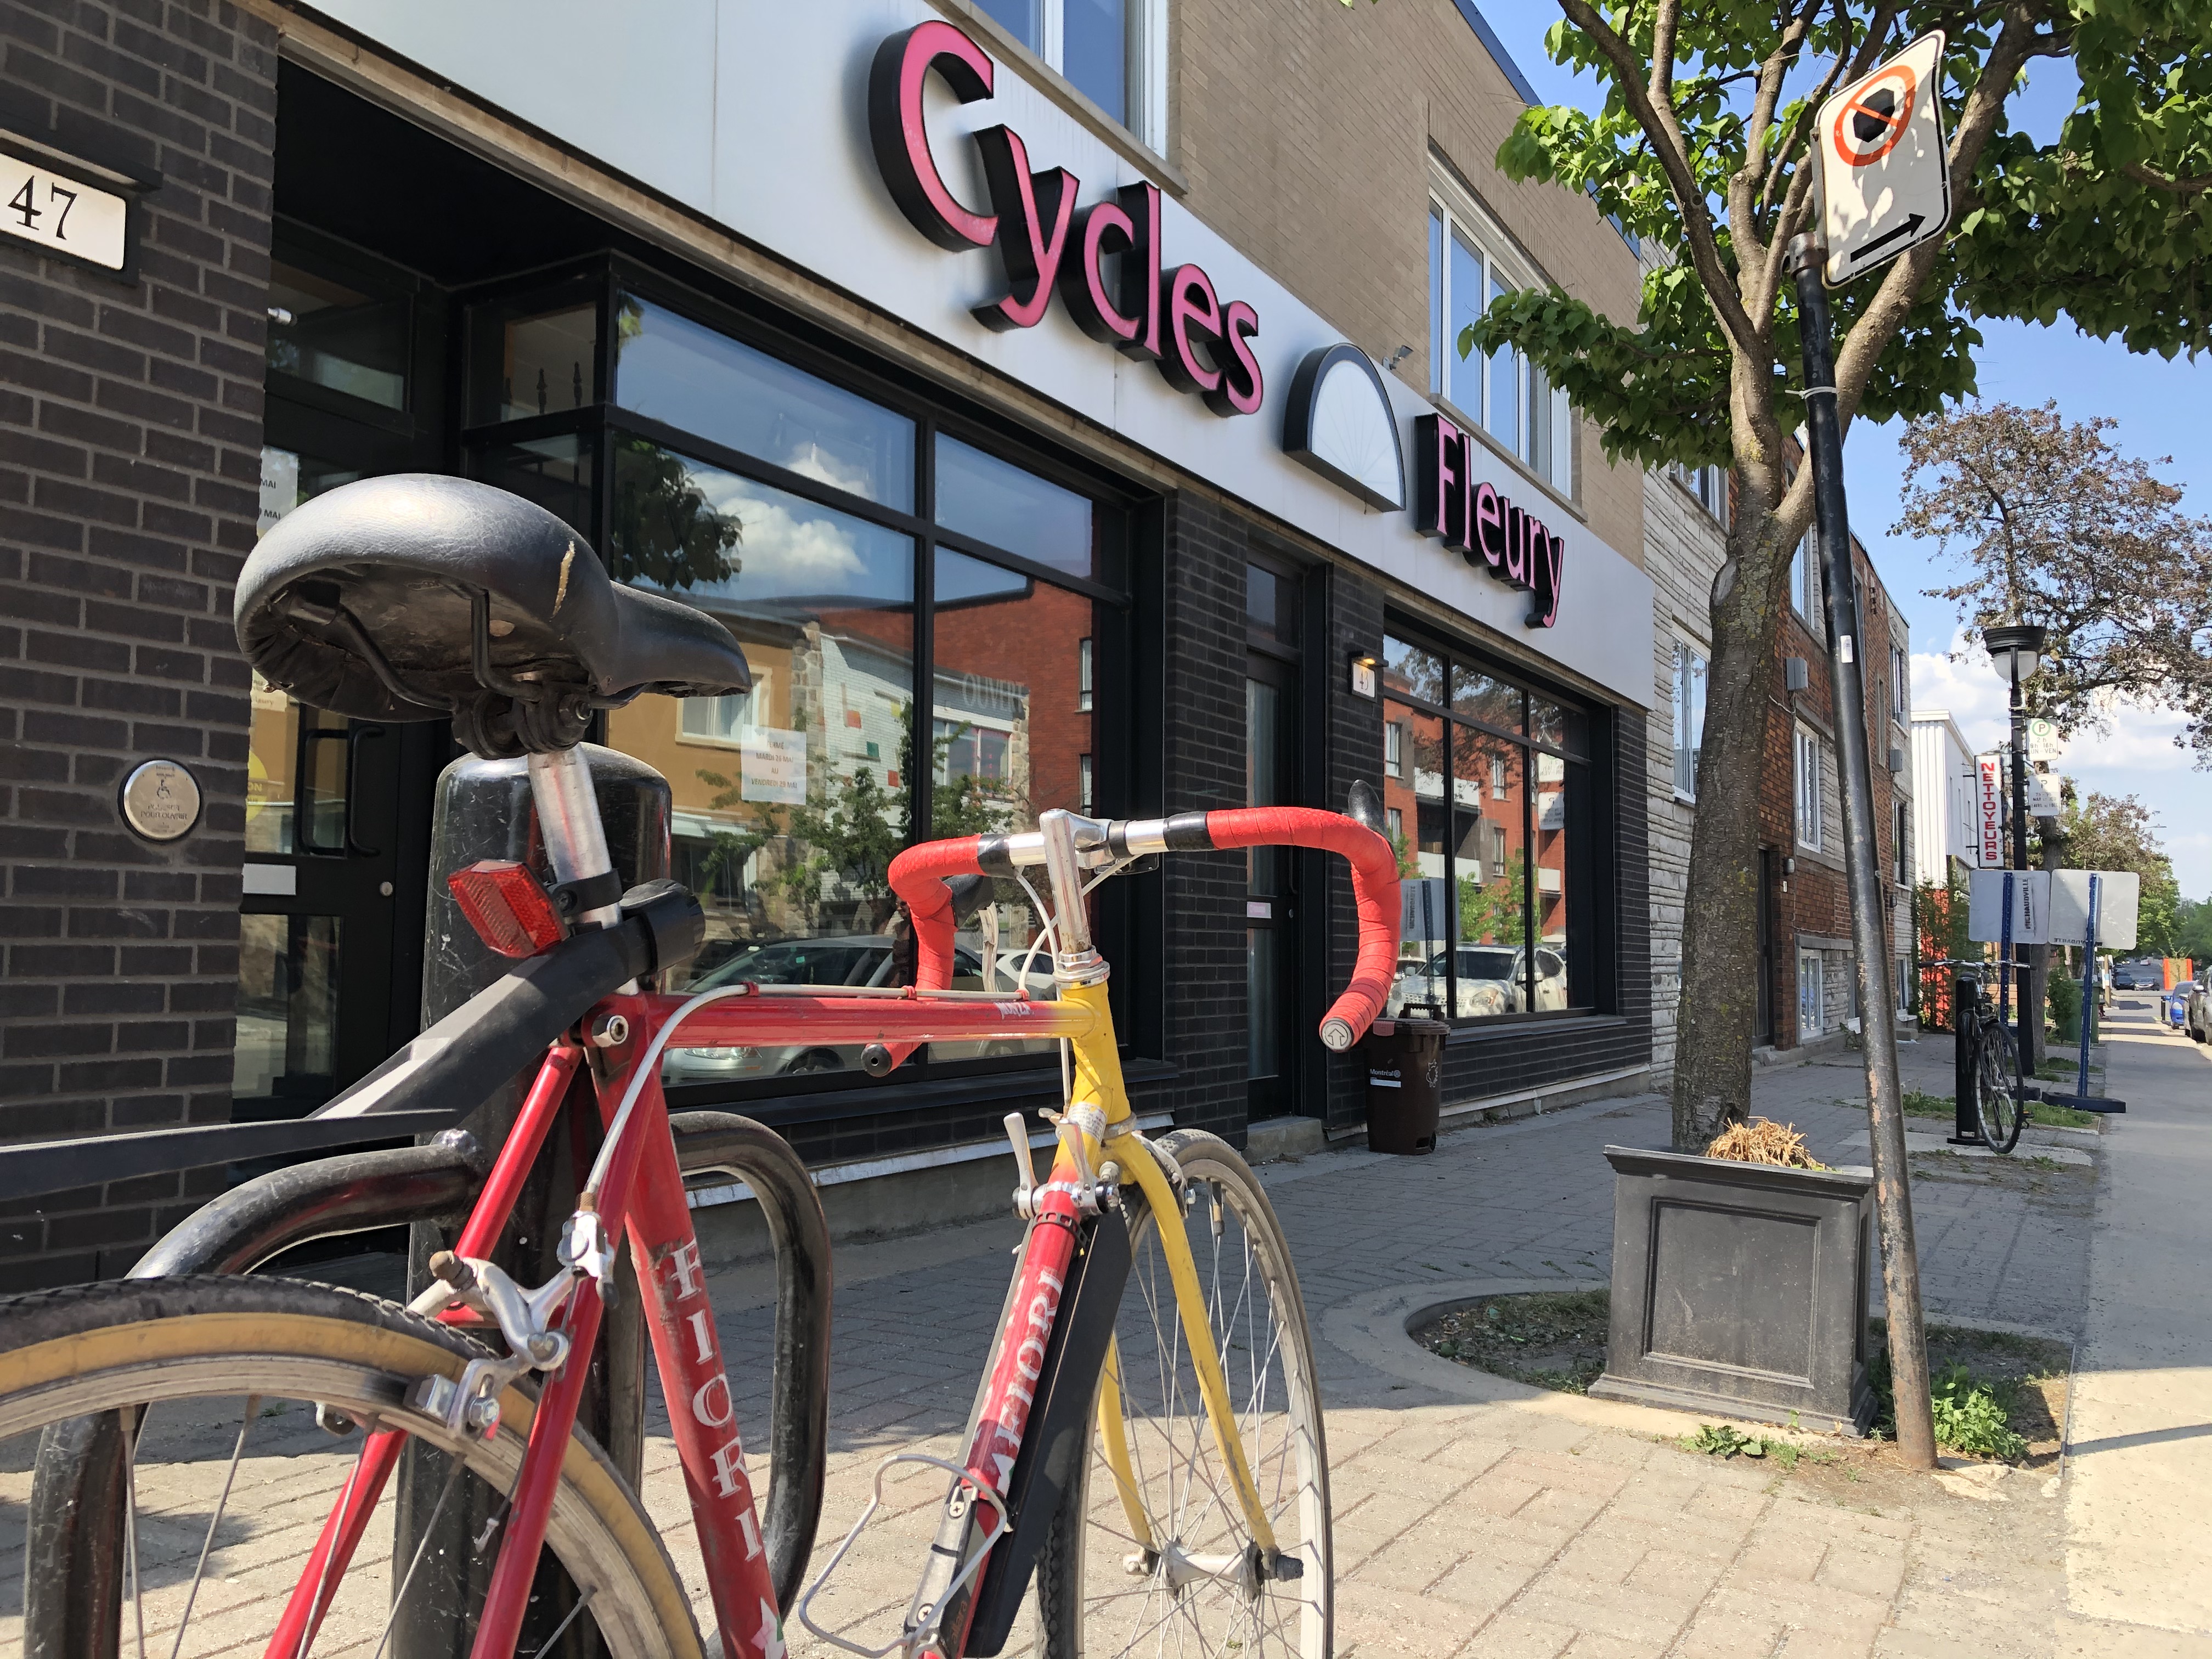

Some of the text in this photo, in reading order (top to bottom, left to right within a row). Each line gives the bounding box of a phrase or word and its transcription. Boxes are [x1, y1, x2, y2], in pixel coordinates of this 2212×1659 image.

[7, 174, 77, 240] 47
[878, 20, 1263, 416] Cycles
[1425, 413, 1565, 628] Fleury
[1359, 670, 1369, 691] 43
[756, 752, 775, 761] MARDI
[2039, 724, 2046, 732] P
[751, 777, 778, 787] VENDREDI
[1981, 763, 1997, 860] NETTOYEURS
[994, 1268, 1063, 1449] FIORI
[669, 1237, 763, 1562] FIORI
